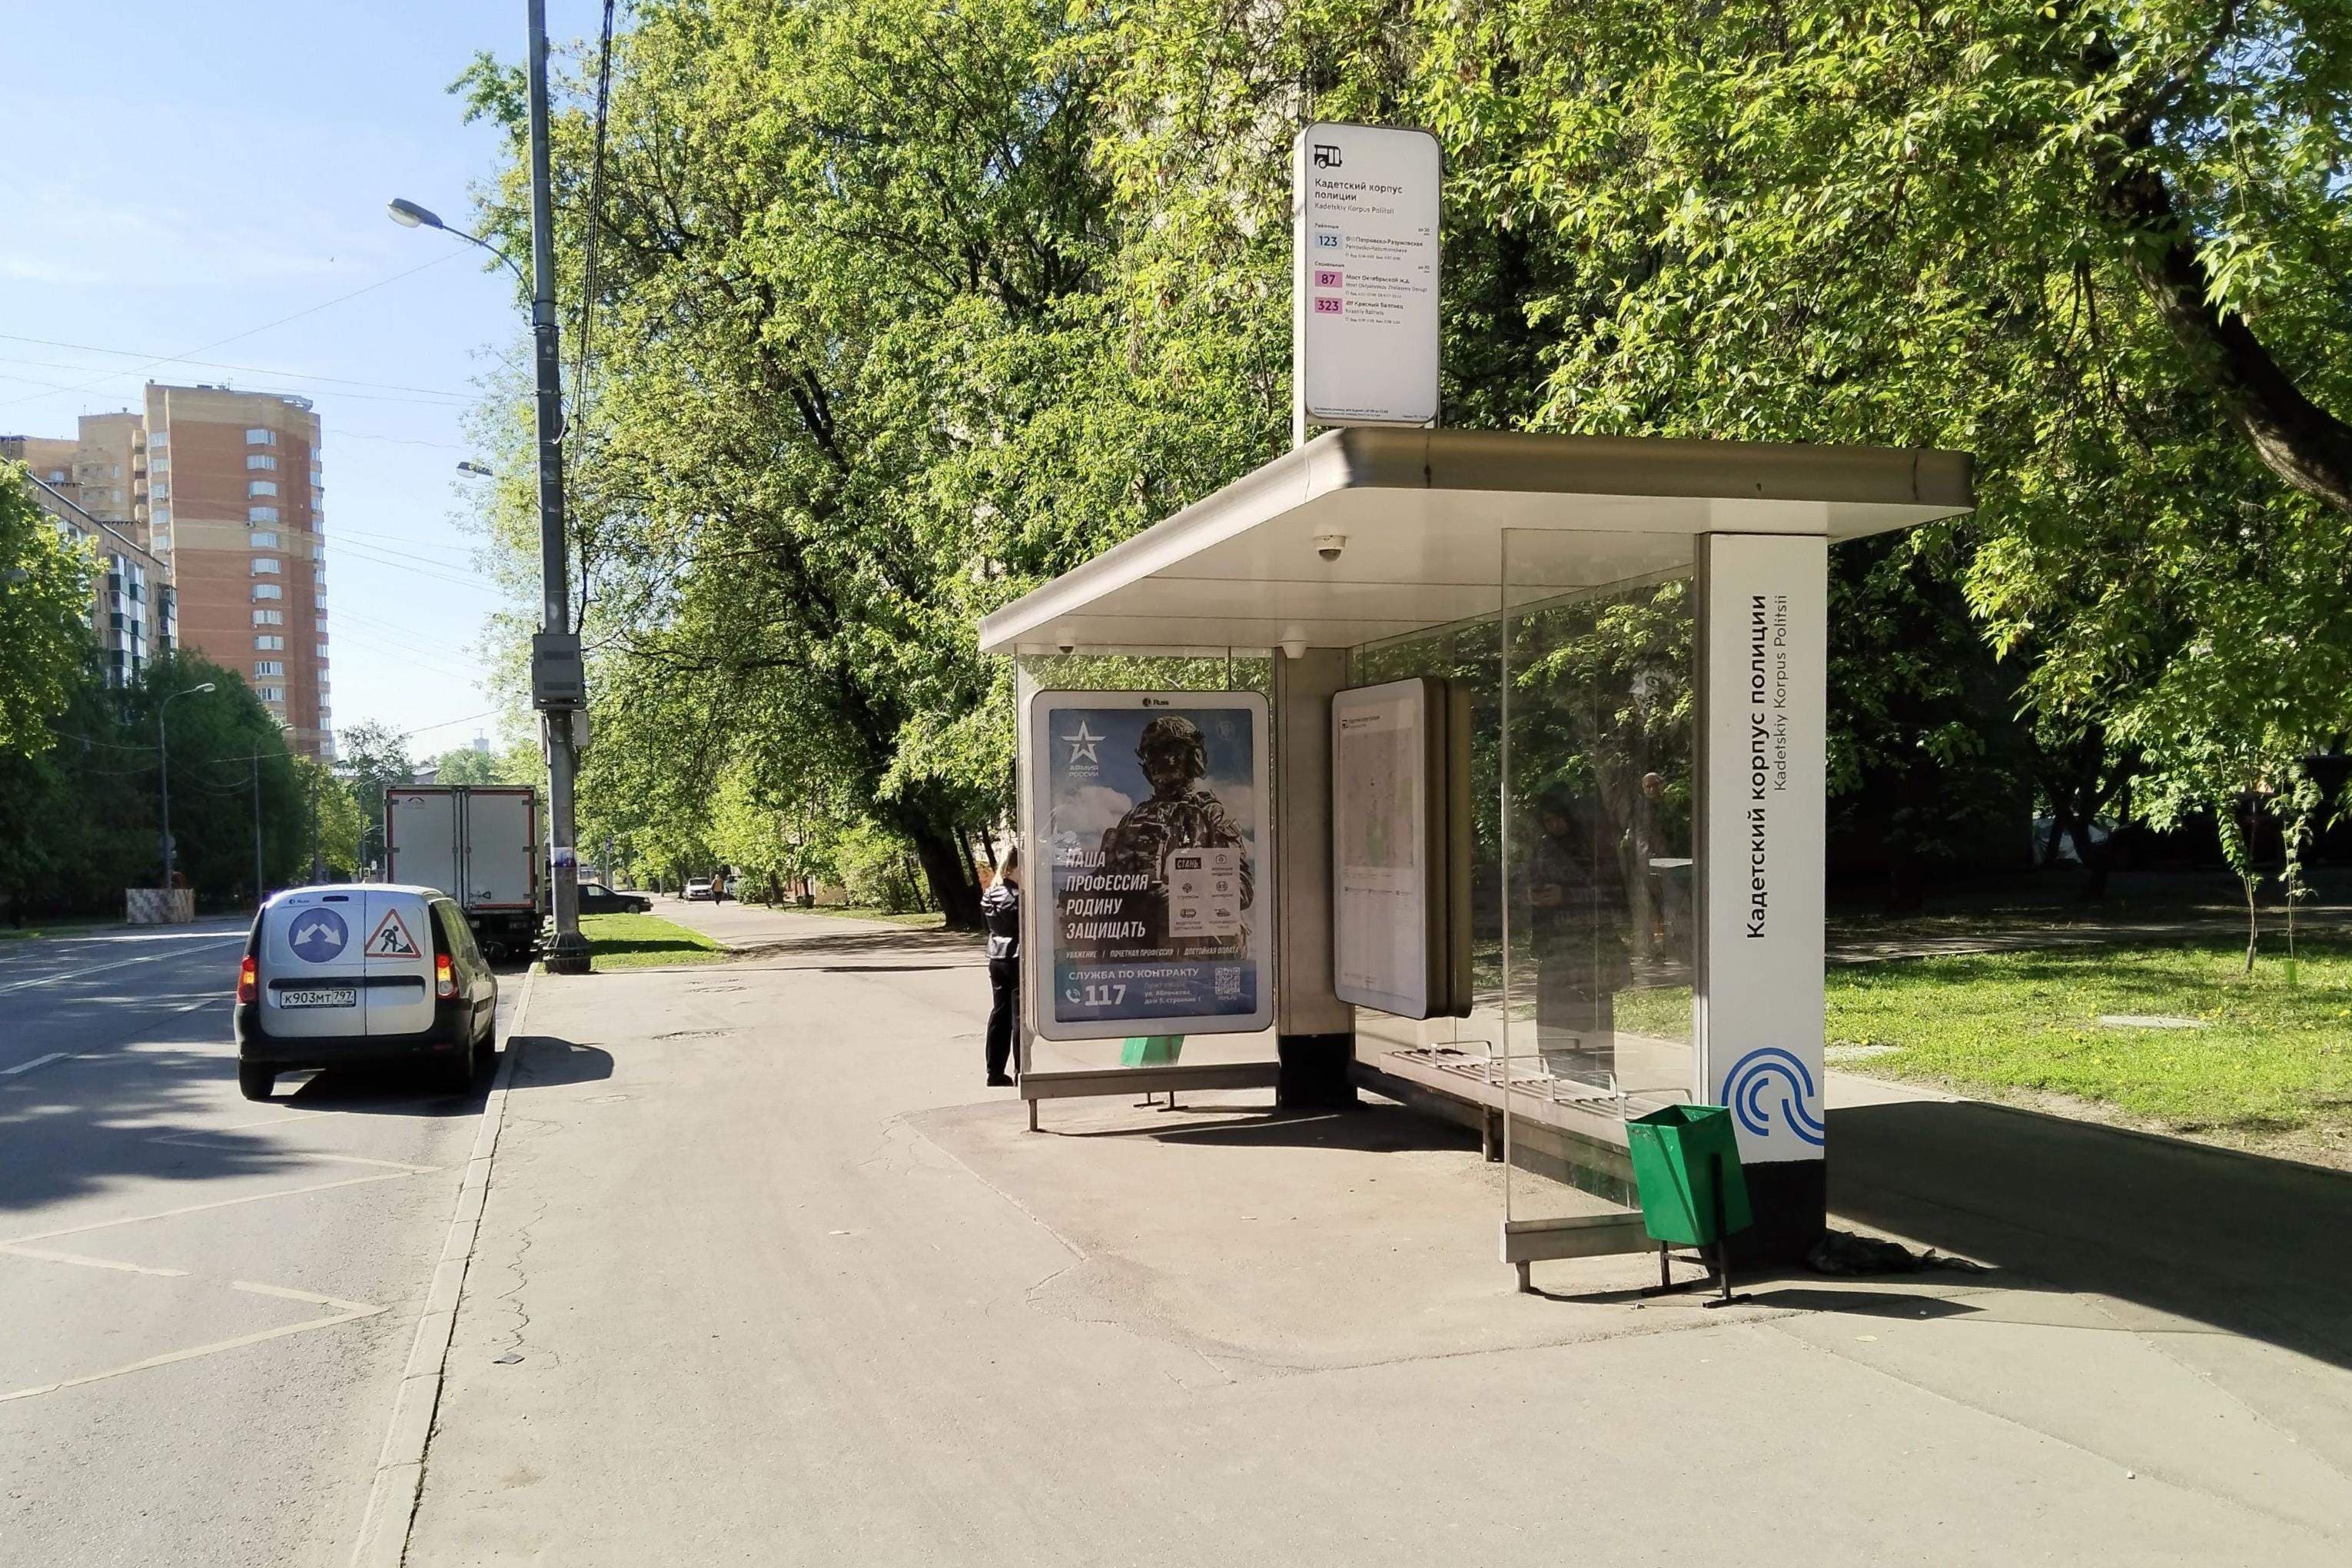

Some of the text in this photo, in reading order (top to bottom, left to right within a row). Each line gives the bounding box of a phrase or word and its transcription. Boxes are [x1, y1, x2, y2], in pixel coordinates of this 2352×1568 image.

[1315, 178, 1403, 194] Кадетский корпус
[1315, 191, 1357, 201] полиции
[1319, 235, 1337, 247] 123
[1321, 274, 1335, 284] 87
[1318, 301, 1339, 311] 323
[1774, 594, 1789, 791] Kadetskiy Korpus Politsii
[1746, 595, 1769, 939] Кадетский корпус полиции
[1065, 850, 1106, 868] НАША
[1066, 874, 1148, 892] ПРОФЕССИЯ
[1066, 898, 1122, 917] РОДИНУ
[1066, 921, 1146, 941] ЗАЩИЩАТЬ
[1068, 968, 1199, 980] СЛУЖБА ПО КОНТРАКТУ
[334, 992, 352, 1000] 797
[1085, 984, 1127, 1006] 117
